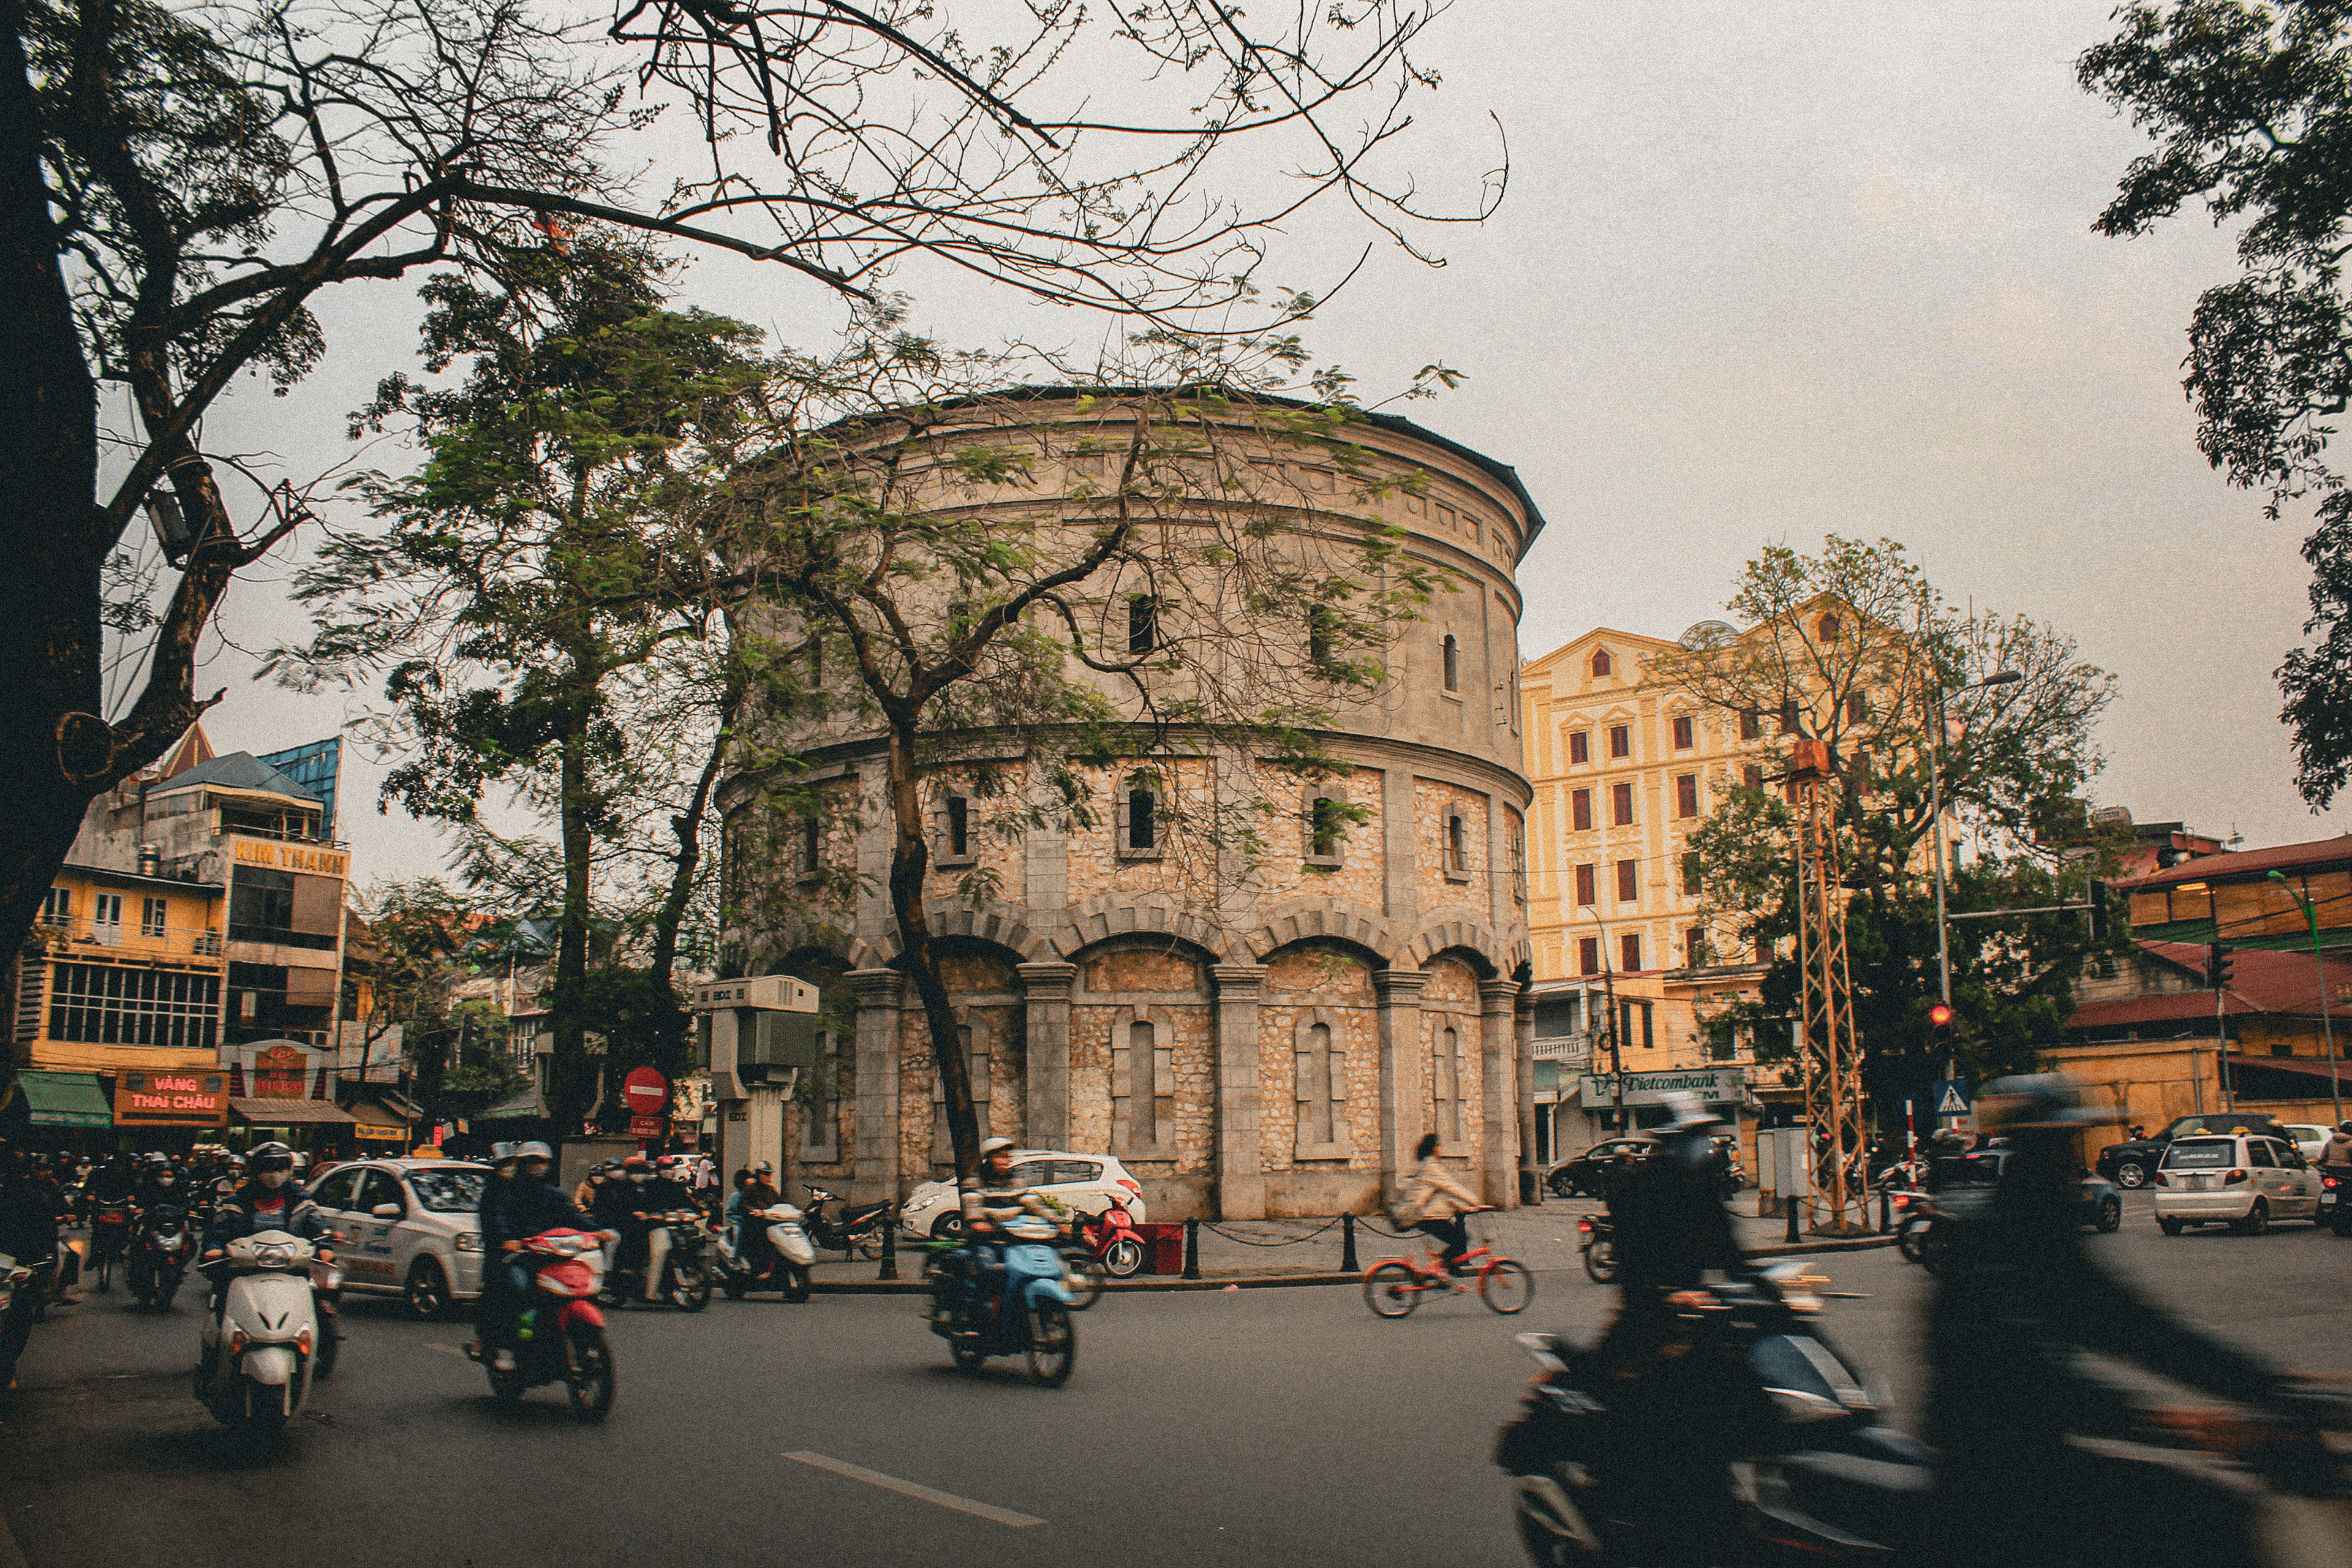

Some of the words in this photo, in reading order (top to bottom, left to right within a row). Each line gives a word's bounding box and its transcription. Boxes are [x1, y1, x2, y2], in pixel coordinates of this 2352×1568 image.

[236, 840, 275, 864] KIM
[282, 847, 346, 874] THANH
[154, 1075, 197, 1091] VÀNG
[1624, 1074, 1719, 1091] Vietcombank
[173, 1094, 216, 1109] CHÂU
